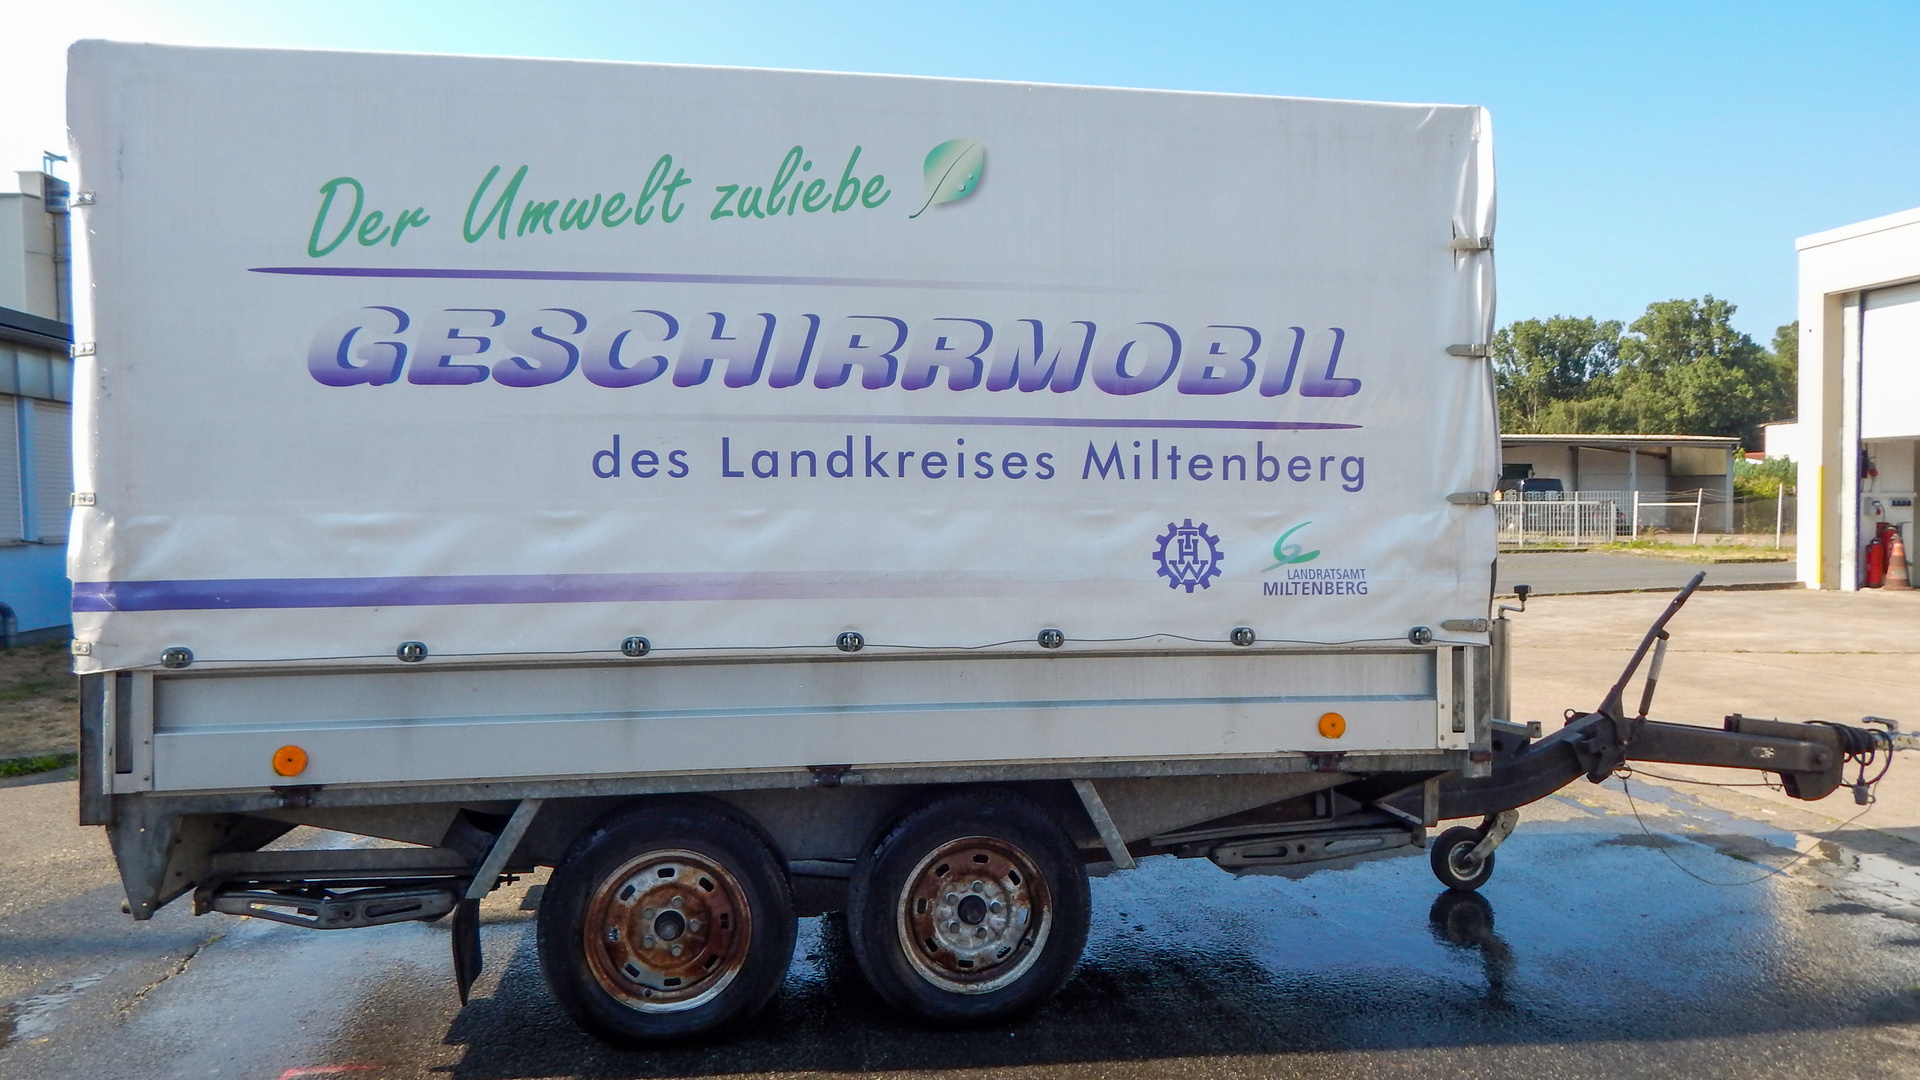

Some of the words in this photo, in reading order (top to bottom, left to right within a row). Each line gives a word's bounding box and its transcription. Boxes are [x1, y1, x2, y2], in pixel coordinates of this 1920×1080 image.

[307, 176, 430, 258] Der
[463, 154, 692, 243] Umwelt
[710, 145, 892, 221] zuliebe
[307, 306, 1362, 398] GESCHIRRMOBIL
[591, 435, 689, 479] des
[722, 435, 1056, 480] Landkreises
[1081, 439, 1365, 493] Miltenberg
[1169, 530, 1208, 581] THW
[1287, 568, 1366, 580] LANDRATSAMT
[1263, 581, 1368, 596] MILTENBERG
